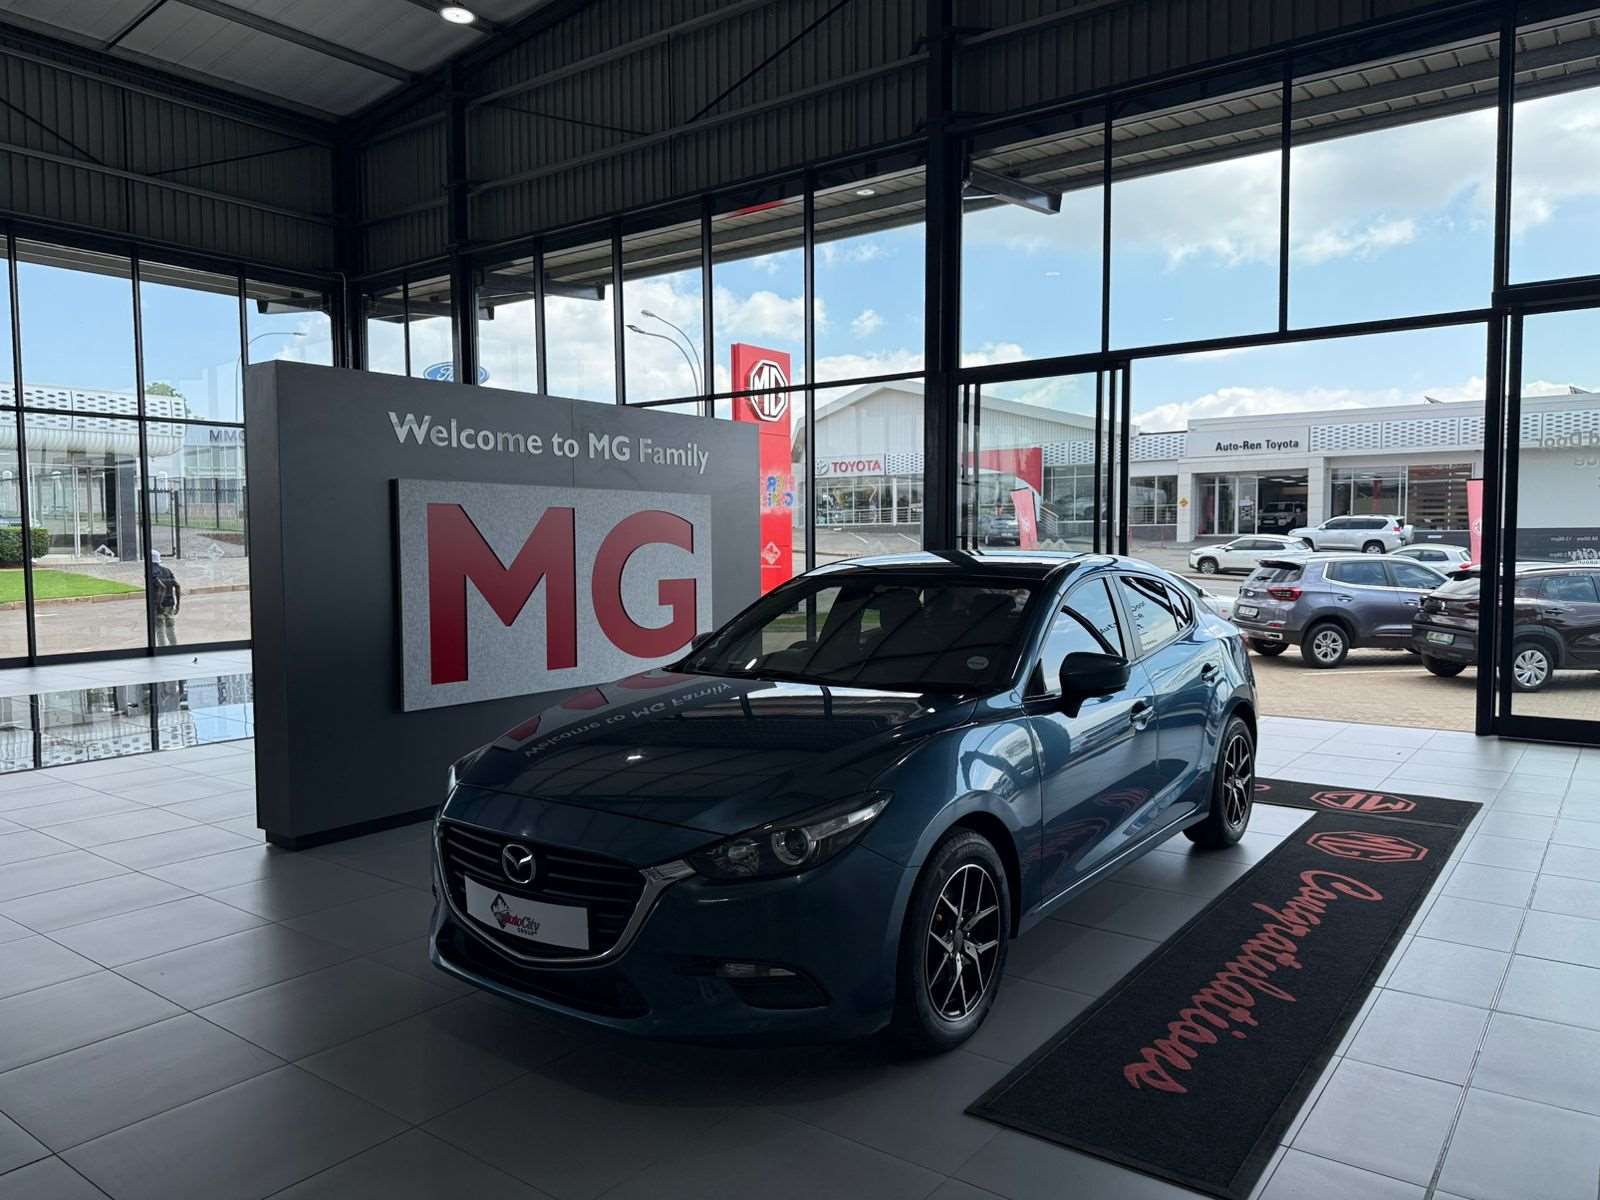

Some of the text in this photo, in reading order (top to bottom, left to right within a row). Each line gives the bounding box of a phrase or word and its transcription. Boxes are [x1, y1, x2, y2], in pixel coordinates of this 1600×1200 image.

[752, 362, 787, 419] MG
[388, 411, 710, 474] Welcome to MG Family
[831, 460, 881, 472] TOYOTA
[1216, 439, 1299, 452] Auto-Ren Toyota
[427, 503, 697, 686] MG
[1311, 832, 1422, 861] MG
[1124, 870, 1384, 1093] Congratulations
